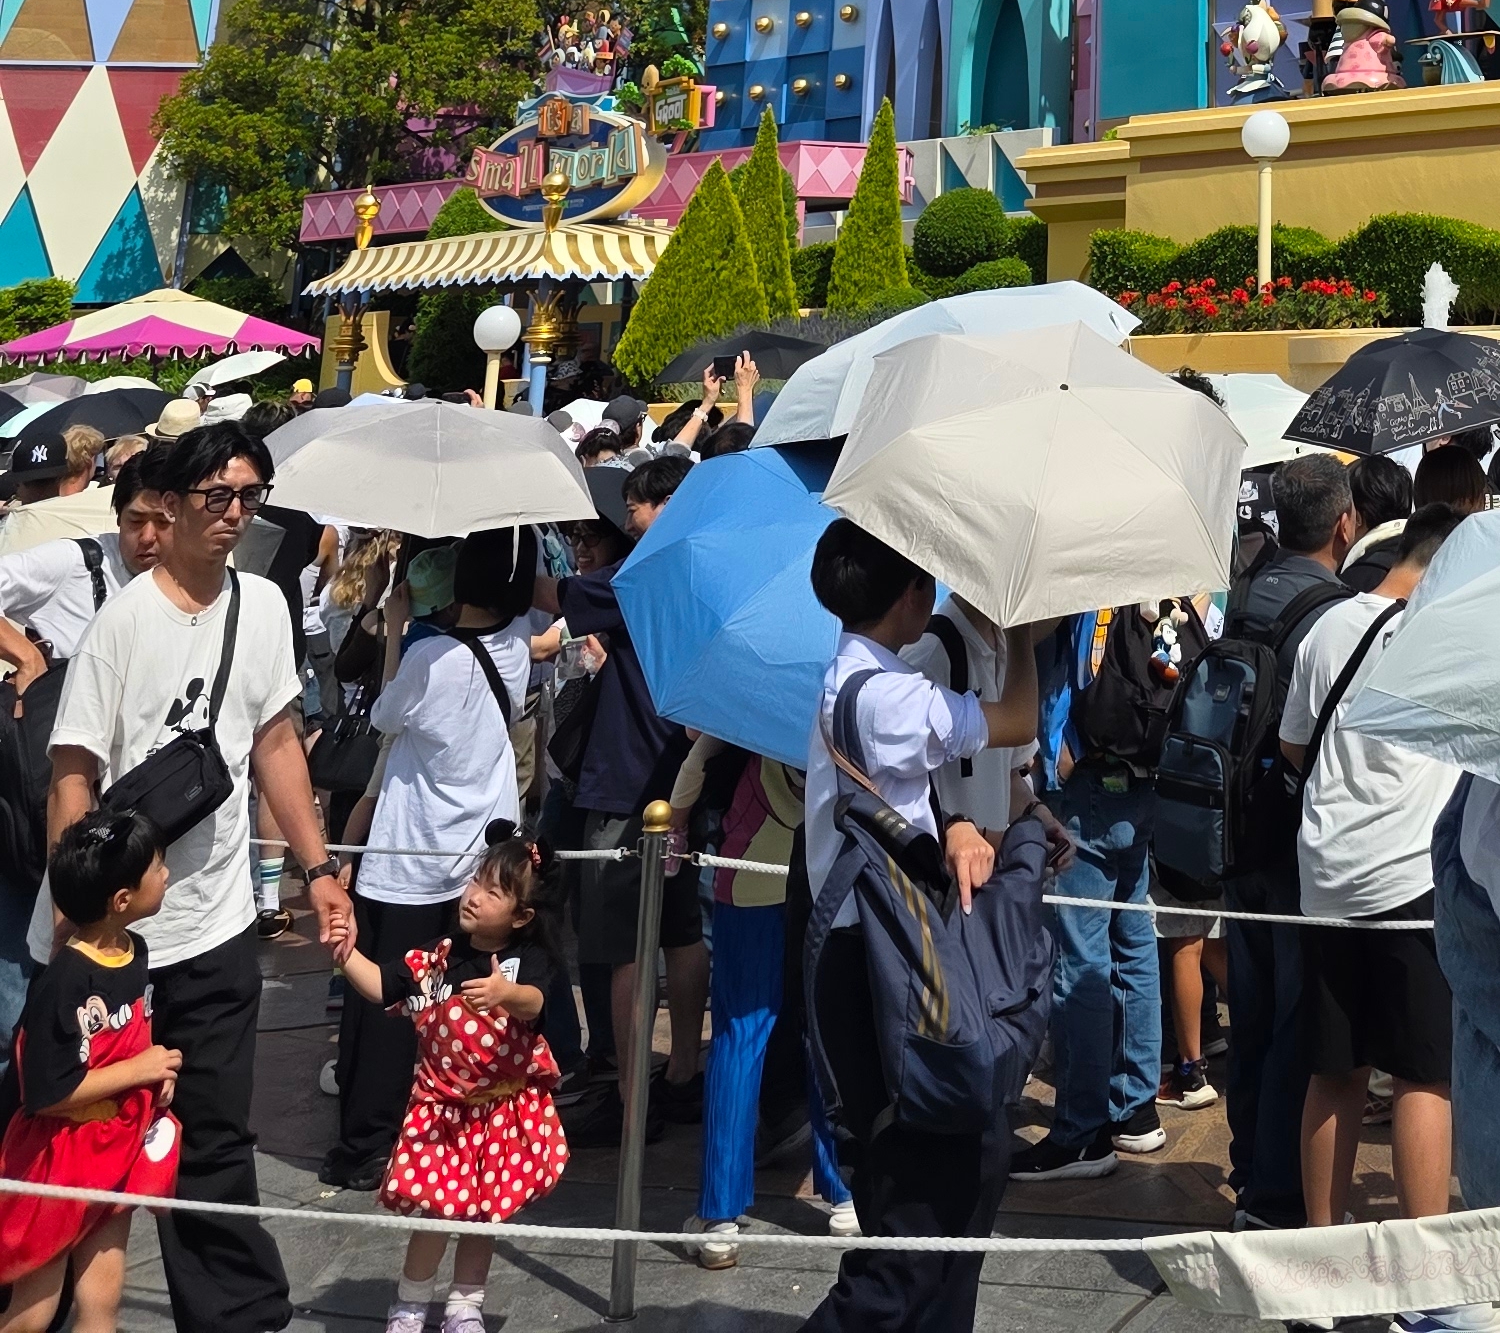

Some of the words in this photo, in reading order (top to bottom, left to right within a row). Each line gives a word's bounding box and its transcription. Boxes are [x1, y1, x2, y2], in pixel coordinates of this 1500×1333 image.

[571, 108, 583, 132] a
[655, 94, 688, 125] GROOT
[466, 145, 538, 191] small
[550, 134, 632, 182] world
[31, 444, 48, 462] NY
